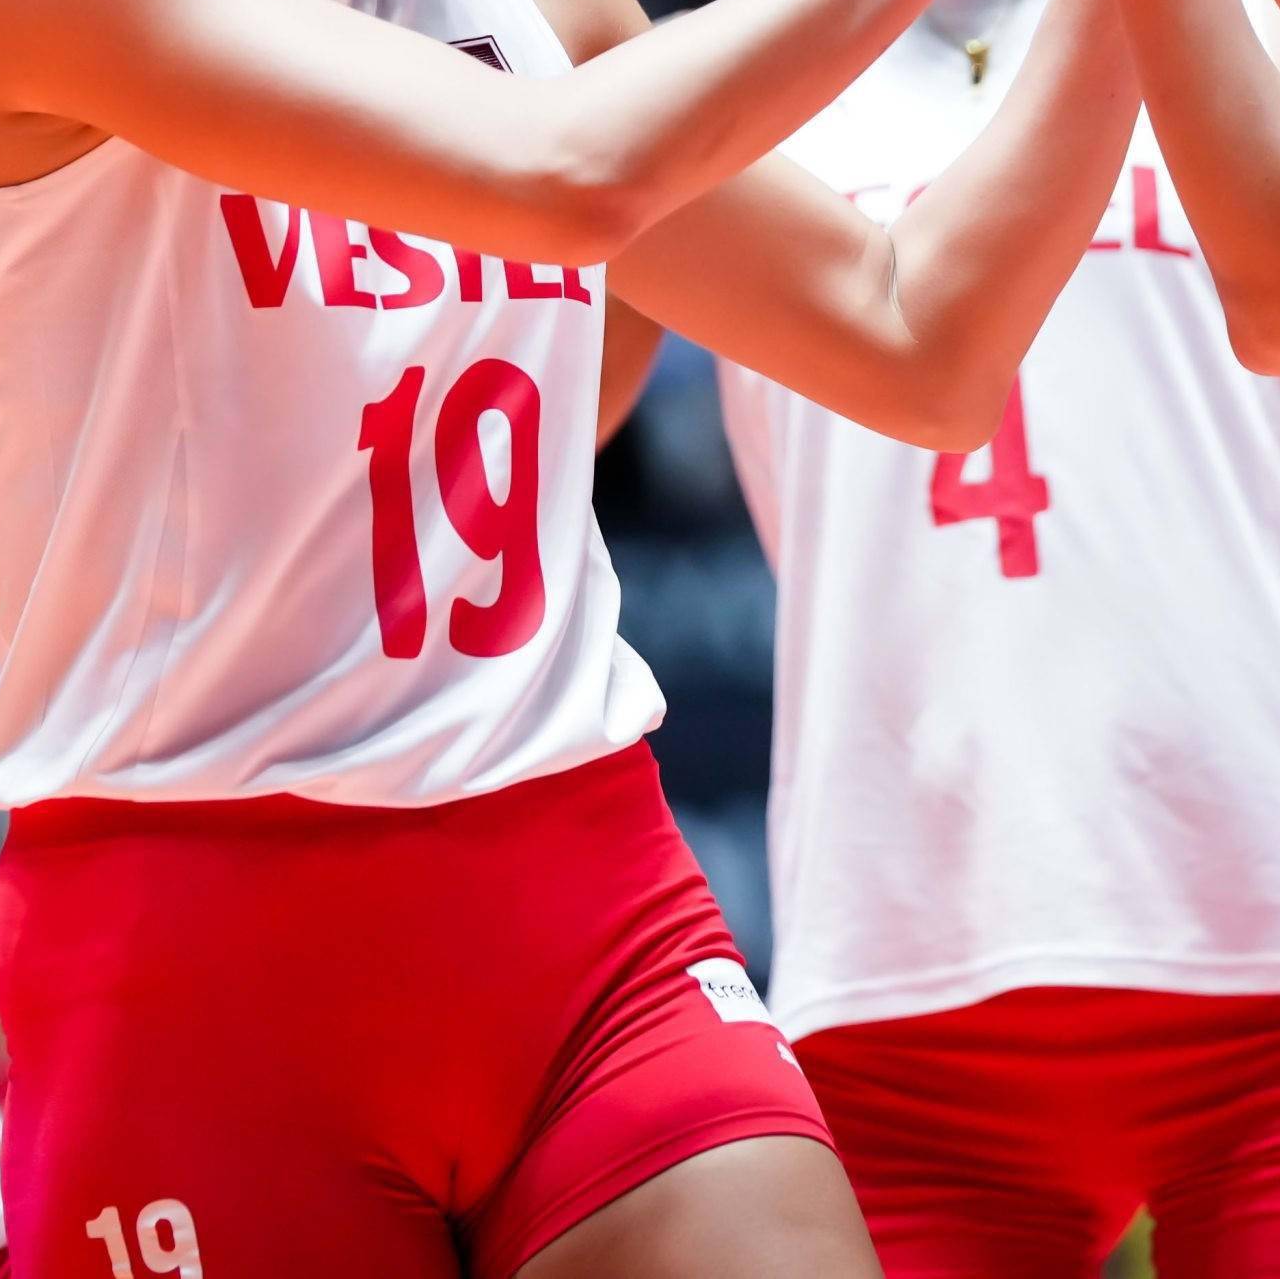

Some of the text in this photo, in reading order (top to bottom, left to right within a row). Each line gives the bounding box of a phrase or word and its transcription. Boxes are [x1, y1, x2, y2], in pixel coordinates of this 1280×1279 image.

[357, 357, 546, 660] 19
[930, 368, 1051, 579] 4
[85, 1198, 204, 1279] 19
